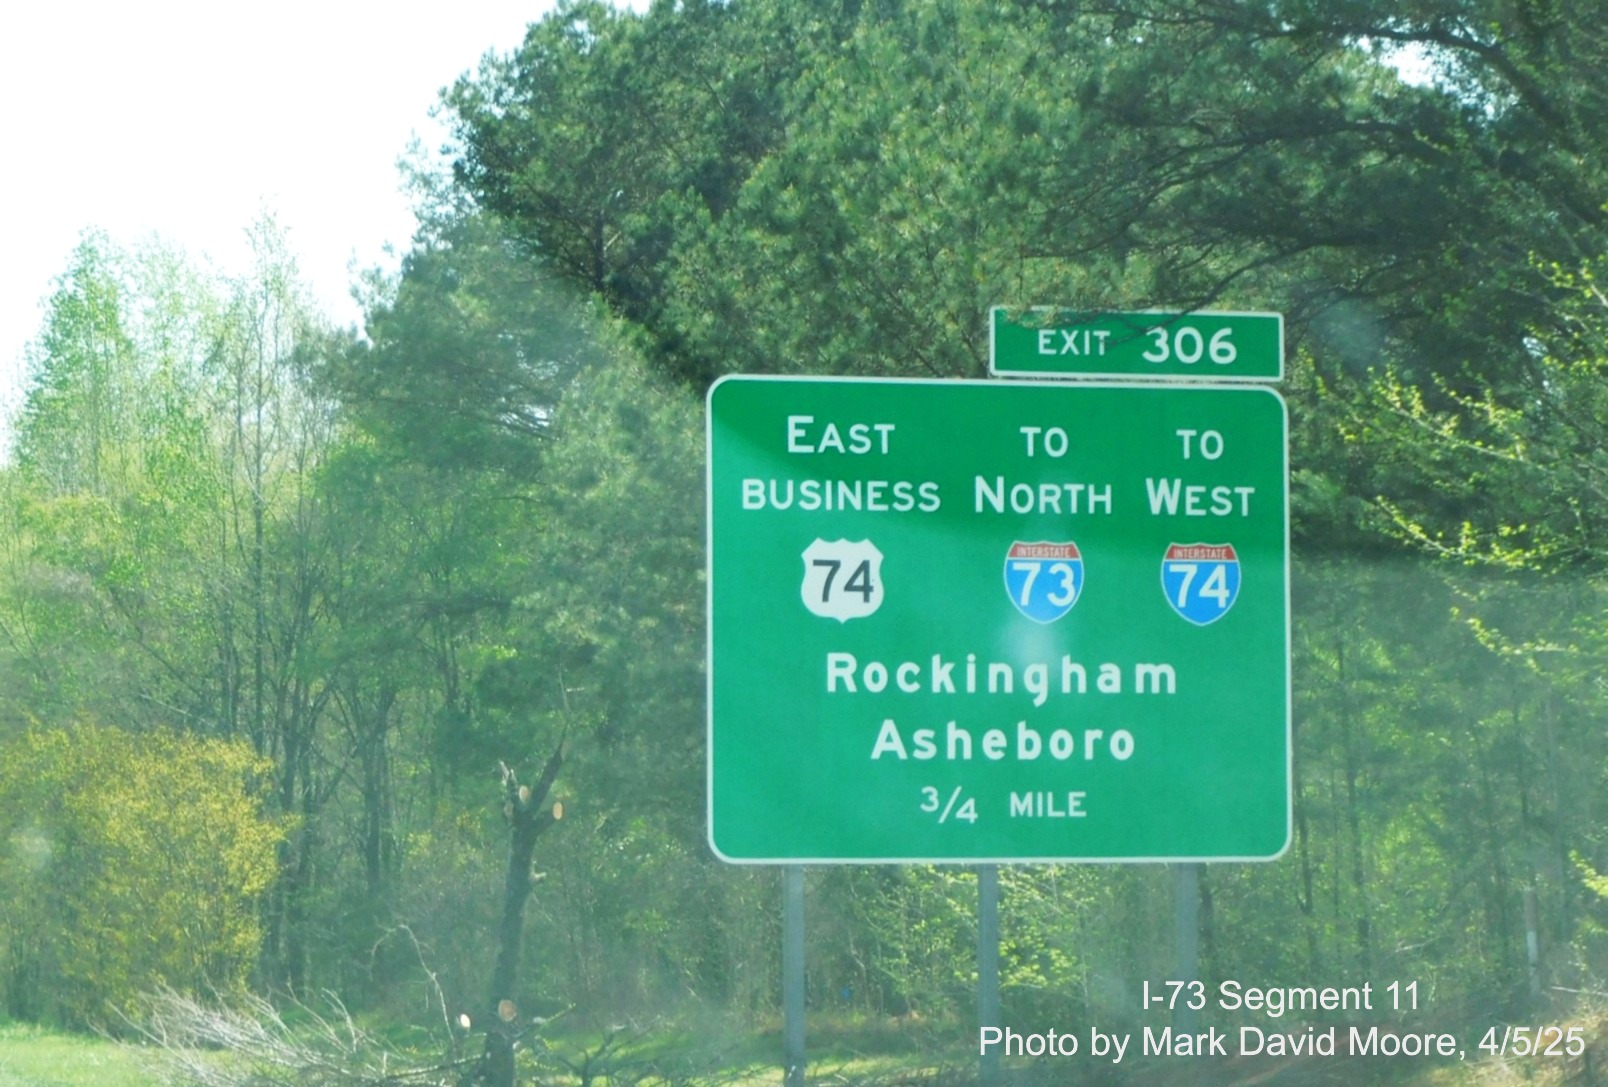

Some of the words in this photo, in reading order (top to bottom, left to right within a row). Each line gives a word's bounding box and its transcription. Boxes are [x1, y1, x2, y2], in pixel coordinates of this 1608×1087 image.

[1038, 330, 1111, 356] EXIT
[1142, 327, 1238, 365] 306
[787, 415, 896, 455] EAST
[1020, 426, 1069, 457] TO
[1176, 430, 1224, 460] TO
[742, 479, 941, 513] BUSINESS
[974, 475, 1113, 515] NORTH
[1146, 478, 1256, 517] WEST
[1016, 547, 1071, 559] INTERSTATE
[1172, 548, 1228, 561] INTERSTATE
[812, 559, 875, 604] 74
[1012, 562, 1077, 607] 73
[1169, 564, 1231, 609] 74
[826, 652, 1177, 708] Rockingham
[870, 719, 1135, 761] Asheboro
[920, 786, 979, 824] 3/4
[1009, 792, 1087, 818] MILE
